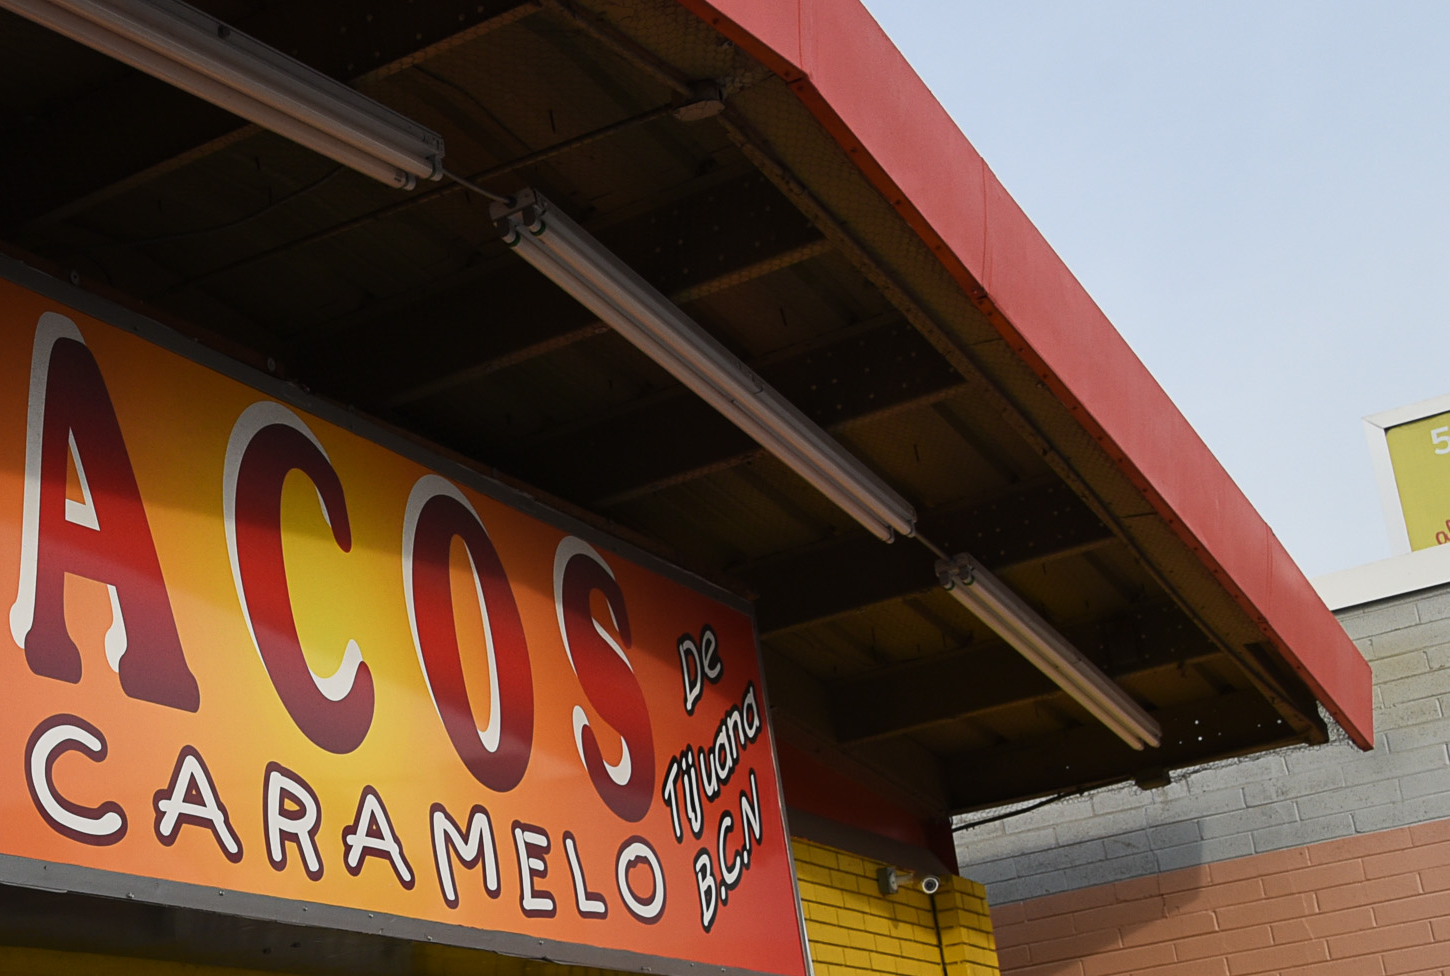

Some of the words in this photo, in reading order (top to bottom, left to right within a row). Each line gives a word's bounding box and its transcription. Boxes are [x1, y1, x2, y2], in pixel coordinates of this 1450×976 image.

[677, 624, 723, 716] De
[25, 713, 667, 925] CARAMELO
[662, 680, 762, 843] Tijuana
[694, 768, 763, 933] B.C.N
